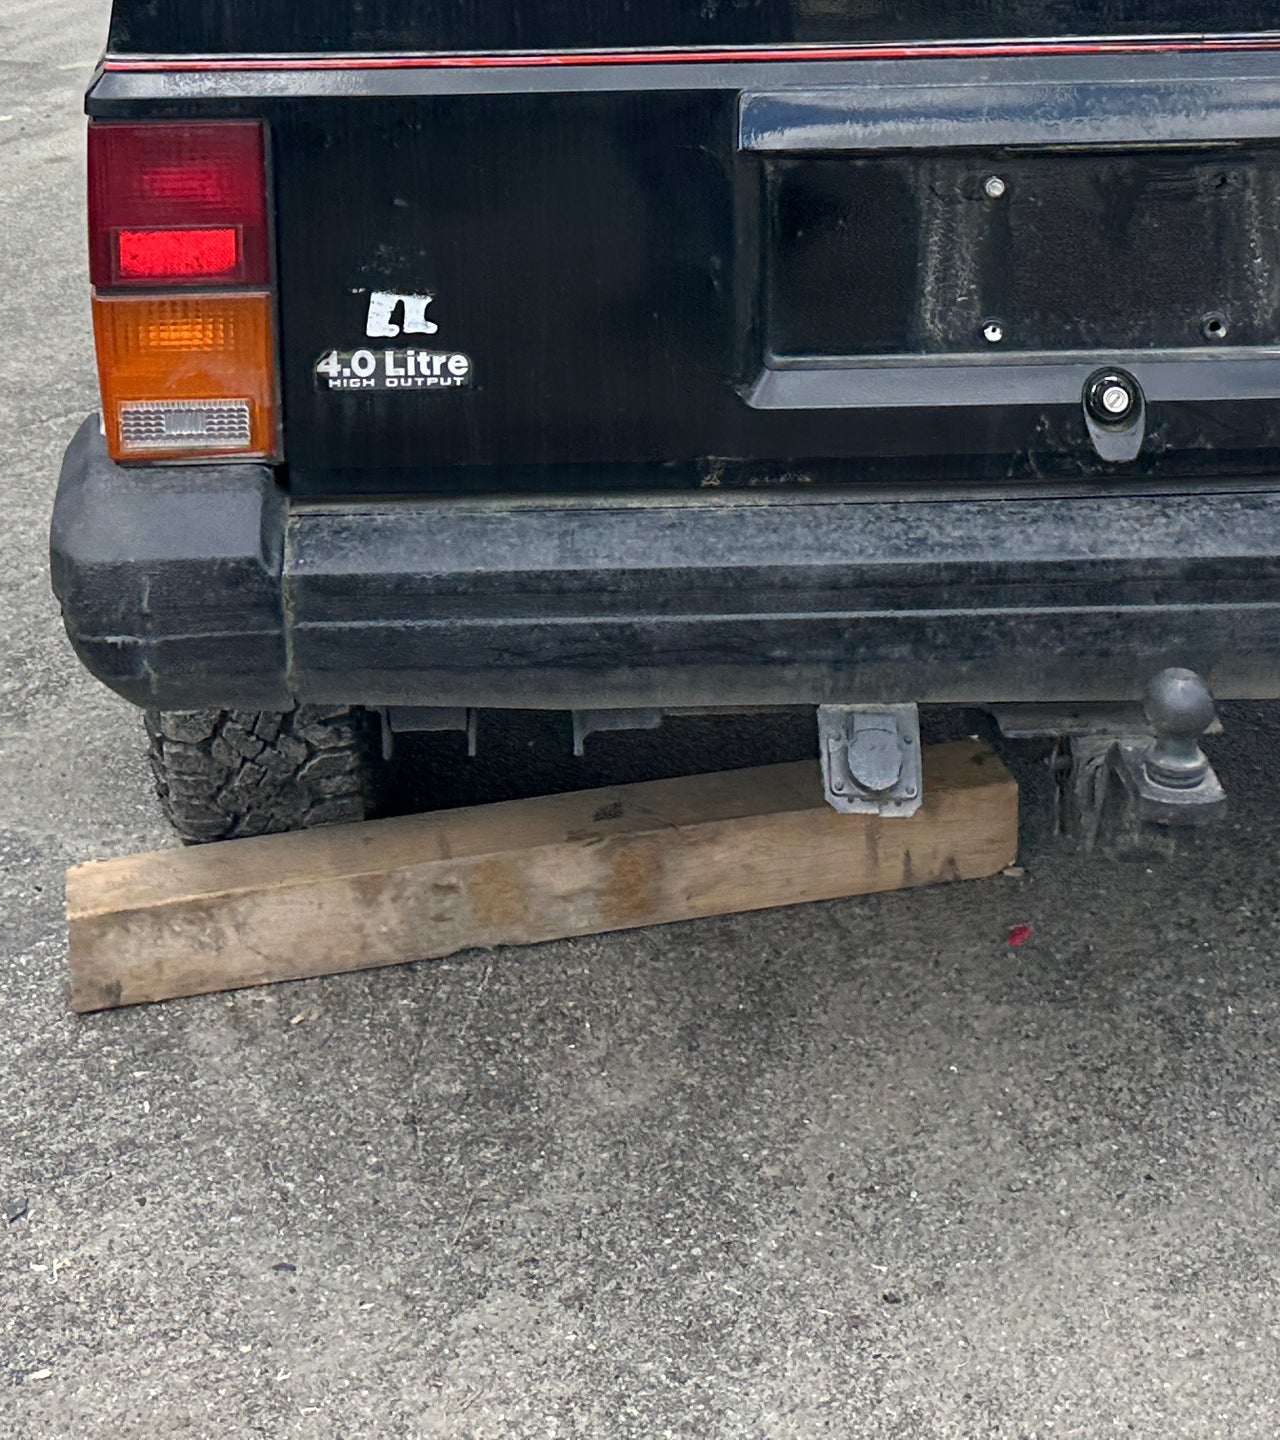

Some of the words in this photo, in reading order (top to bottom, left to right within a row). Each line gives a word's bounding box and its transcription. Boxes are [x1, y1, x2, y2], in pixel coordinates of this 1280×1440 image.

[316, 349, 376, 378] 4.0
[385, 349, 469, 377] Litre
[328, 377, 376, 388] HIGH
[385, 376, 465, 387] OUTPUT
